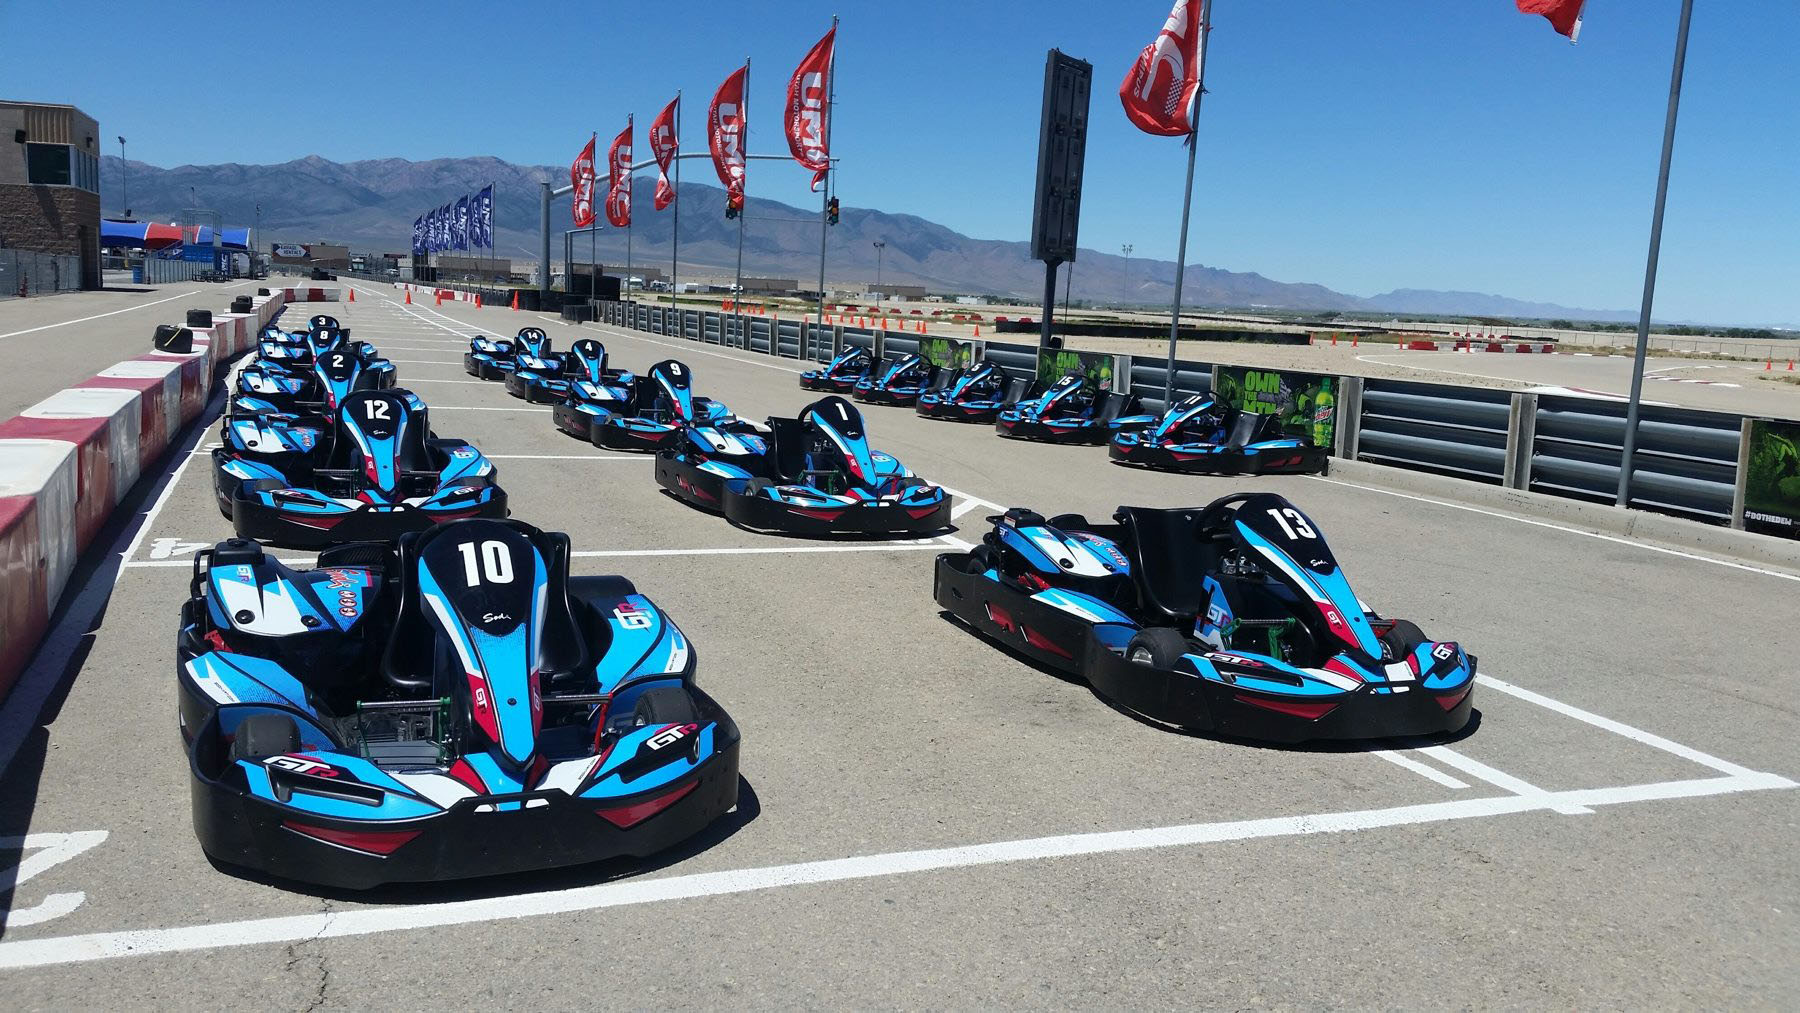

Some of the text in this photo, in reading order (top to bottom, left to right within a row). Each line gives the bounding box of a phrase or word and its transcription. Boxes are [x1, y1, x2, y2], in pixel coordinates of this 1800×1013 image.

[1133, 43, 1155, 98] CAMPUS
[579, 159, 592, 221] UMC
[617, 145, 631, 218] UMC
[319, 317, 326, 325] 3
[319, 331, 329, 339] 8
[585, 342, 593, 351] 4
[332, 355, 344, 367] 2
[670, 363, 682, 375] 9
[971, 363, 983, 372] 5
[1056, 352, 1079, 369] OWN
[1057, 376, 1075, 386] 15
[1244, 371, 1281, 393] OWN
[1184, 395, 1202, 404] 11
[1242, 400, 1277, 414] MTN
[364, 400, 391, 420] 12
[835, 403, 849, 420] 1
[1266, 508, 1318, 540] 13
[1745, 510, 1793, 526] #DOTHEDEW
[458, 540, 514, 587] 10
[646, 723, 698, 751] GTR
[262, 755, 339, 777] GTR
